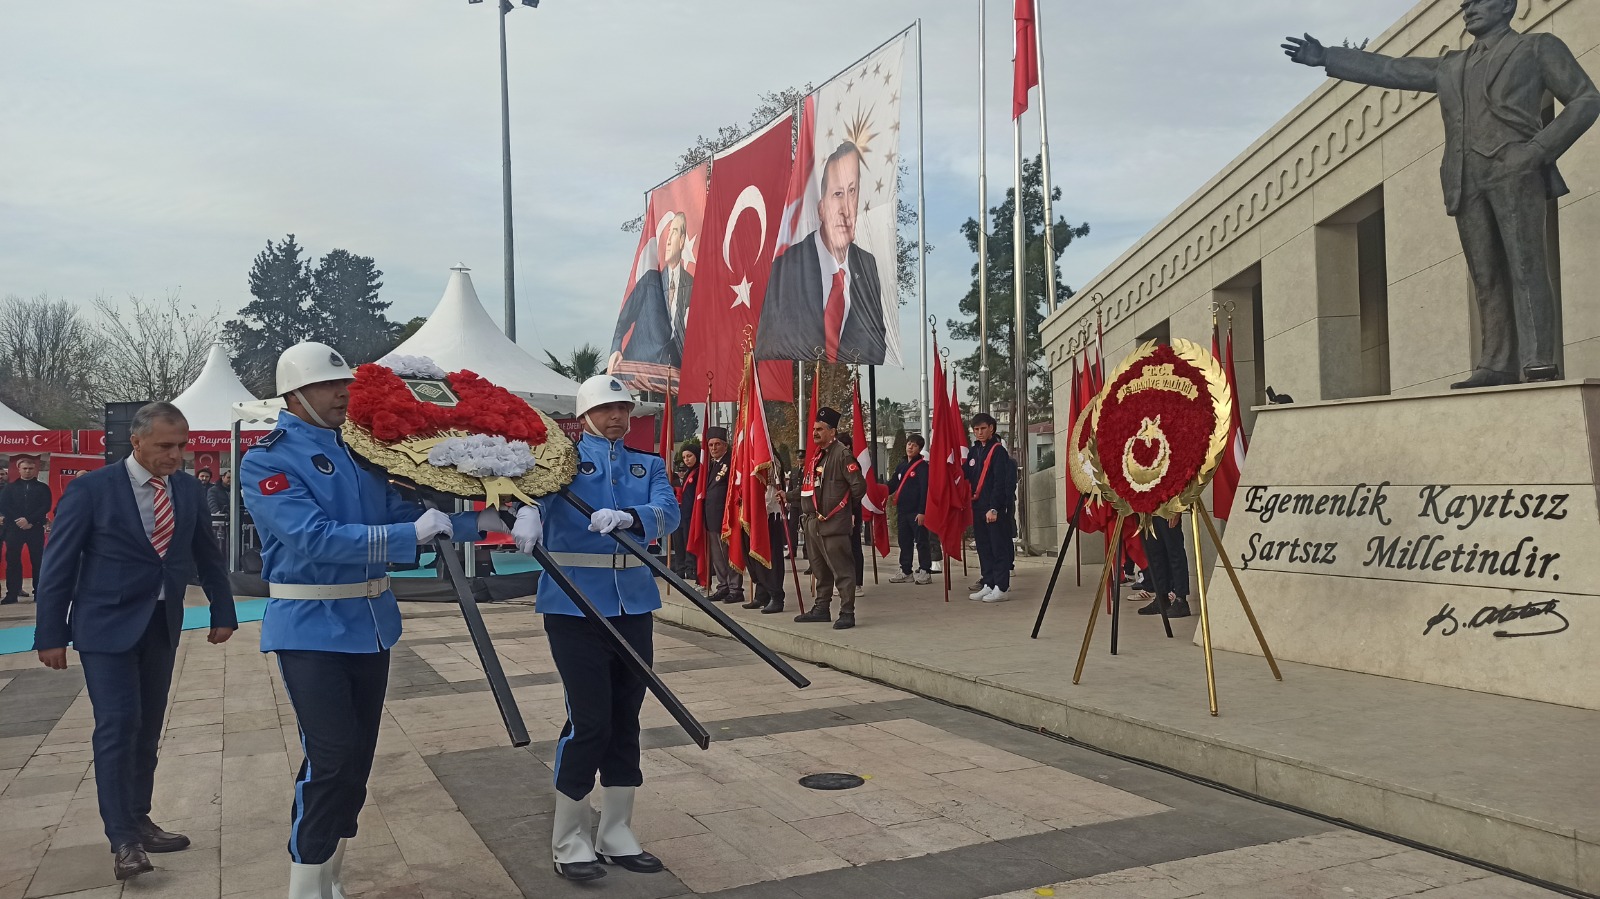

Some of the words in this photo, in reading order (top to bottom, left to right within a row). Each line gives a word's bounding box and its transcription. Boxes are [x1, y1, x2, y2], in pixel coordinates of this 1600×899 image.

[1245, 481, 1392, 526] Egemenlik
[1418, 485, 1570, 531] Kayıtsız
[1241, 532, 1338, 570] Şartsız
[1362, 534, 1561, 581] Milletindir.
